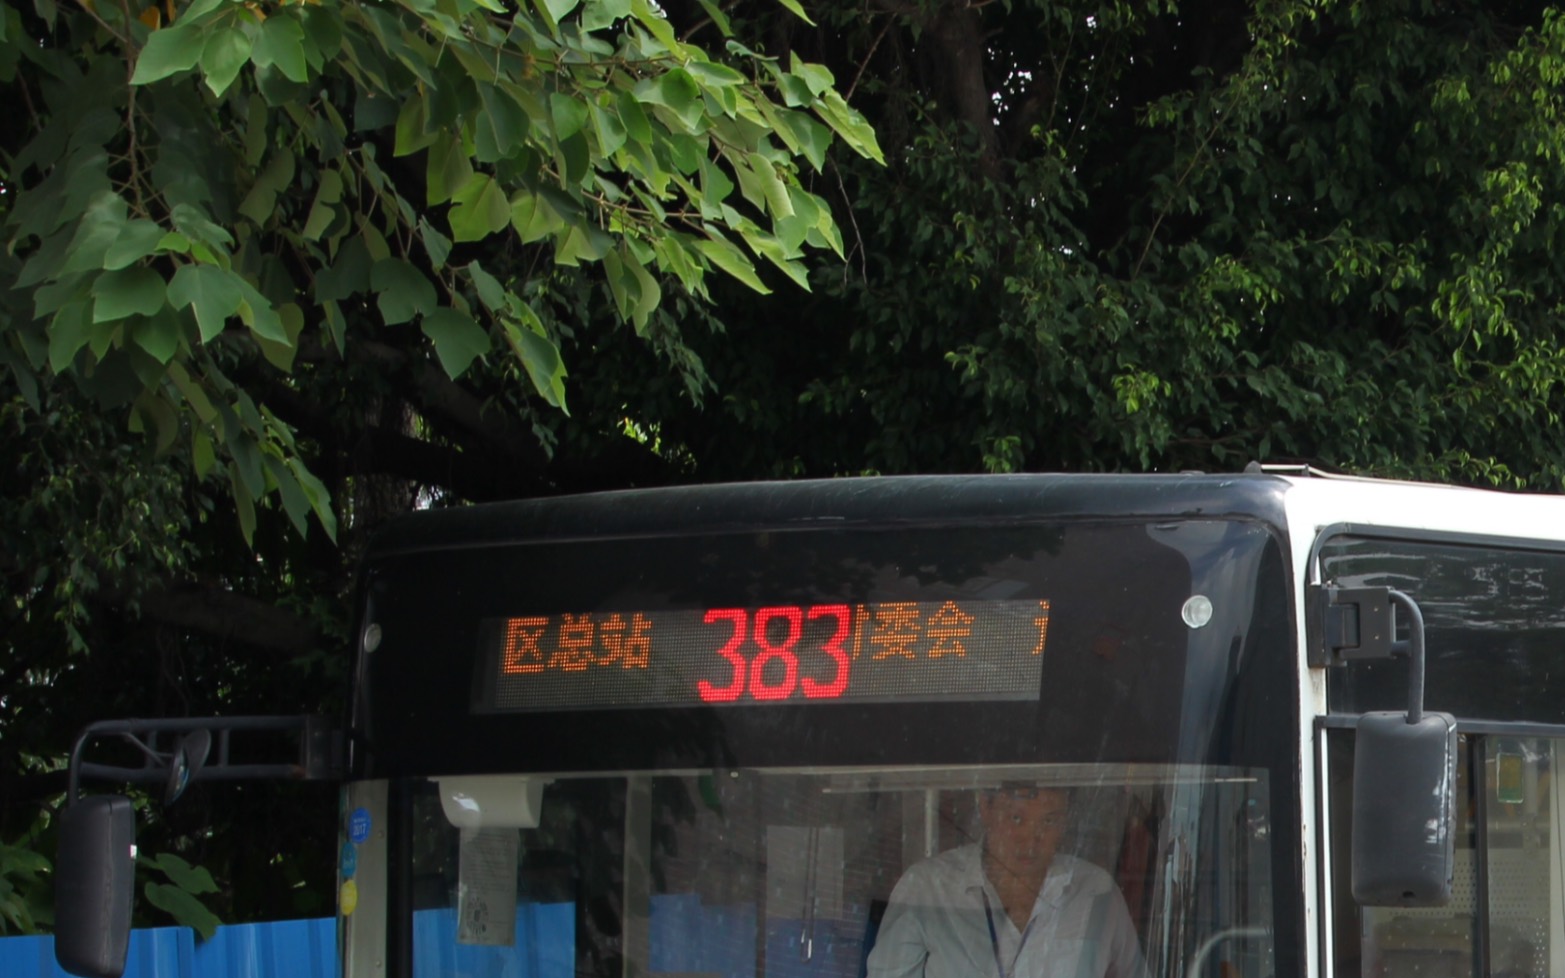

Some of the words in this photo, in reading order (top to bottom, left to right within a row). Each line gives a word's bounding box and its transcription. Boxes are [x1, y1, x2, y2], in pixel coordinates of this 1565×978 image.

[504, 612, 652, 674] 区总站
[698, 604, 851, 702] 383
